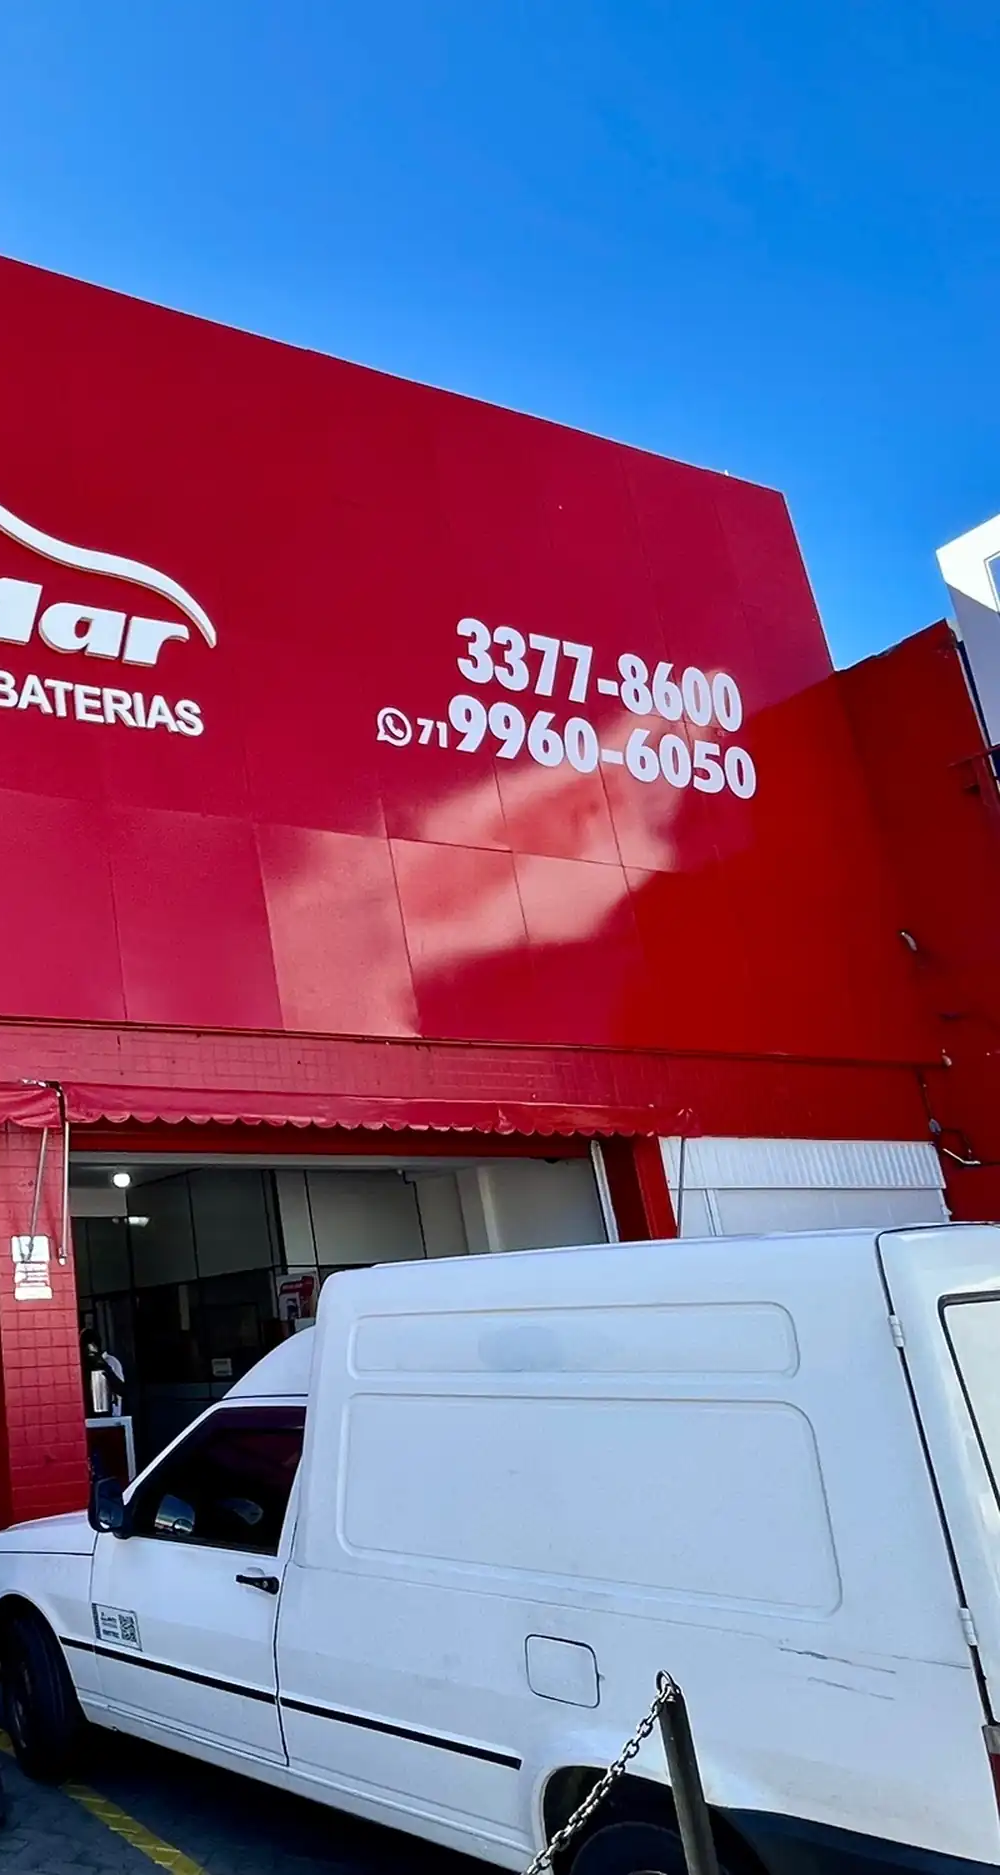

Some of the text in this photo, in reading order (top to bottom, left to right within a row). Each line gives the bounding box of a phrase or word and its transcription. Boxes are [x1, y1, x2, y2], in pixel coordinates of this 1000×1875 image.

[456, 617, 743, 733] 3377-8600
[416, 694, 757, 800] 71 9960-6050
